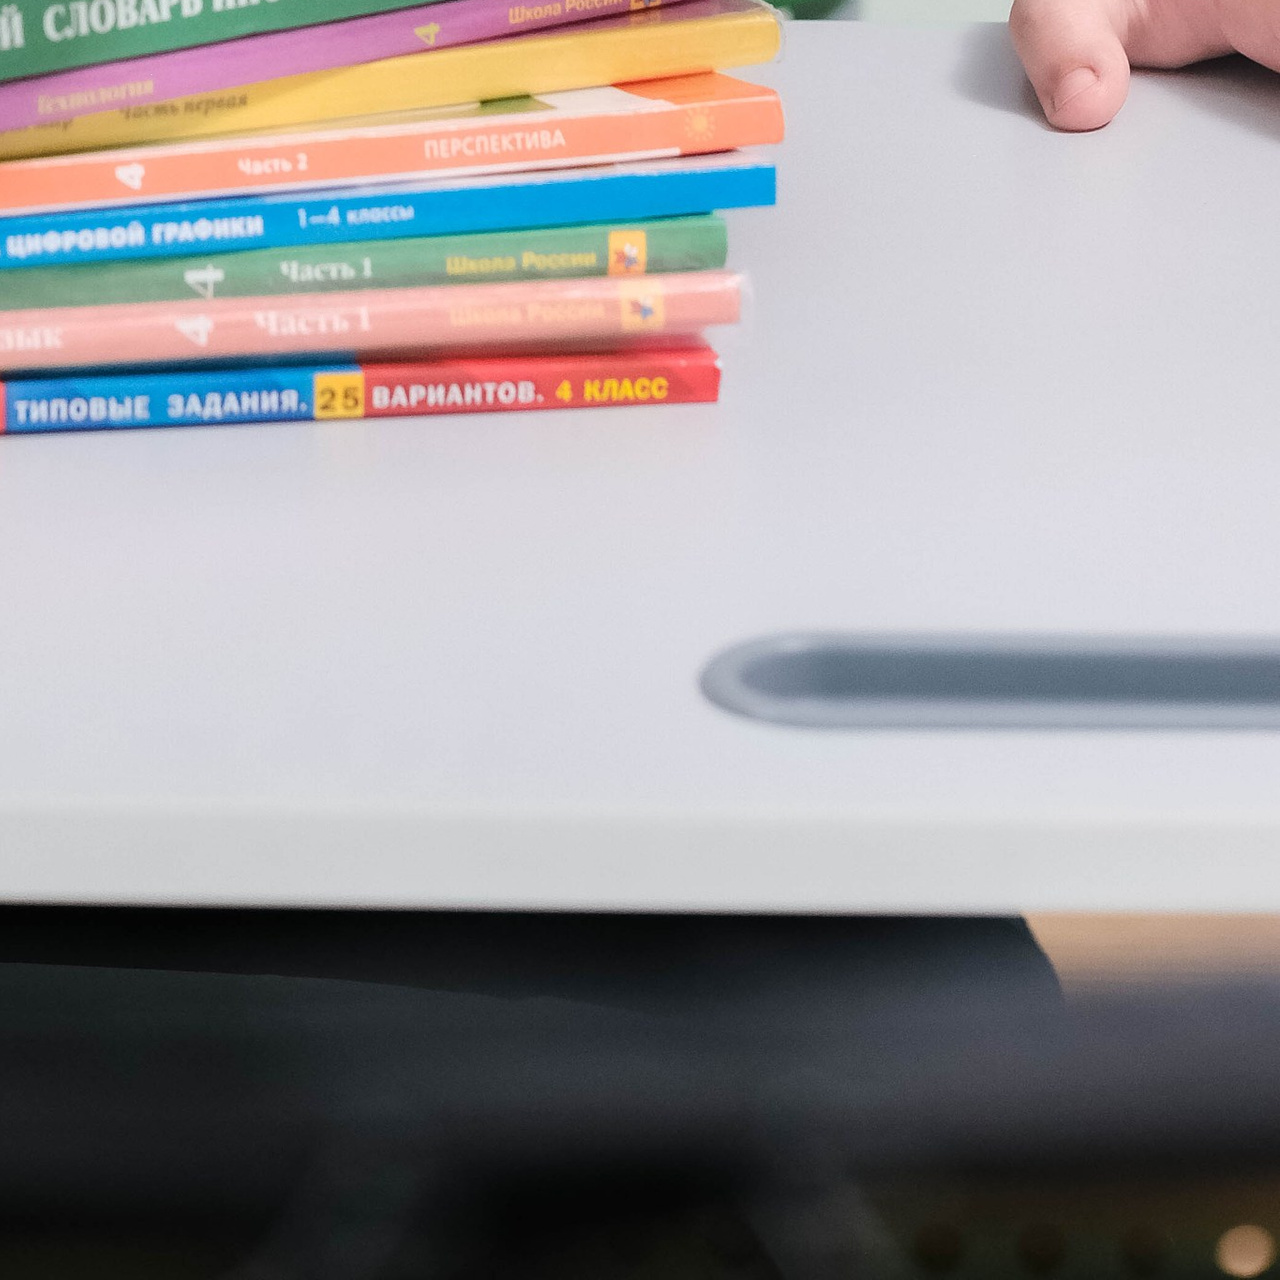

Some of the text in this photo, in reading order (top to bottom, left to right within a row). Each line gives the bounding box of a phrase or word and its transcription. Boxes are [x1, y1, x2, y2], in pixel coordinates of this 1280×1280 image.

[508, 2, 563, 24] Школа
[237, 157, 293, 175] Часть
[296, 152, 309, 172] 2
[424, 129, 566, 160] ПЕРСПЕКТИВА
[6, 219, 145, 259] ЦИФРОВОЙ
[152, 215, 264, 244] ГРАФИКИ
[346, 204, 415, 225] классы
[279, 259, 356, 283] Часть
[363, 256, 373, 278] 1
[445, 254, 517, 276] Школа
[522, 251, 597, 272] России
[253, 307, 350, 337] Часть
[357, 306, 371, 332] 1
[15, 395, 150, 424] ТИПОВЫЕ
[166, 388, 308, 419] ЗАДАНИЯ.
[319, 386, 360, 412] 25
[372, 380, 544, 409] ВАРИАНТОВ.
[554, 381, 573, 403] 4
[583, 376, 669, 401] КЛАСС
